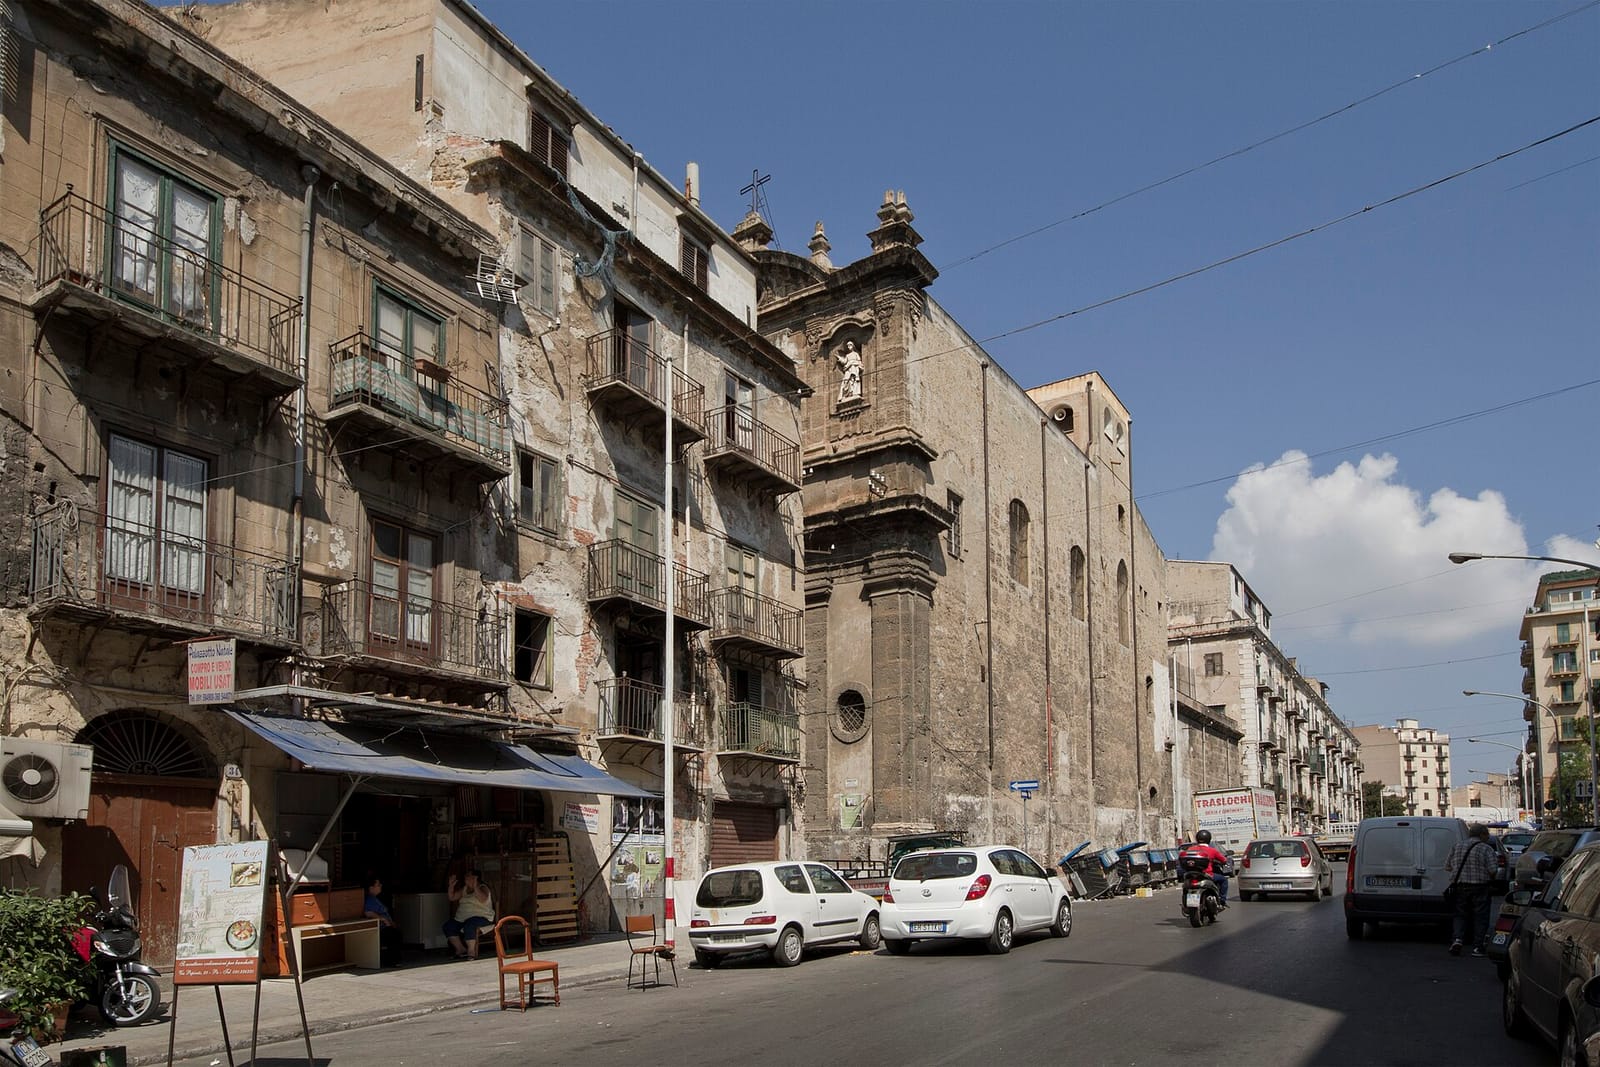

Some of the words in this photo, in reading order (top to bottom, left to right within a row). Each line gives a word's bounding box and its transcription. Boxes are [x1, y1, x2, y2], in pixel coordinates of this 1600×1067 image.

[191, 662, 210, 673] COMPRO
[190, 675, 212, 690] MOBILI
[1195, 795, 1252, 808] TRASLOCHI
